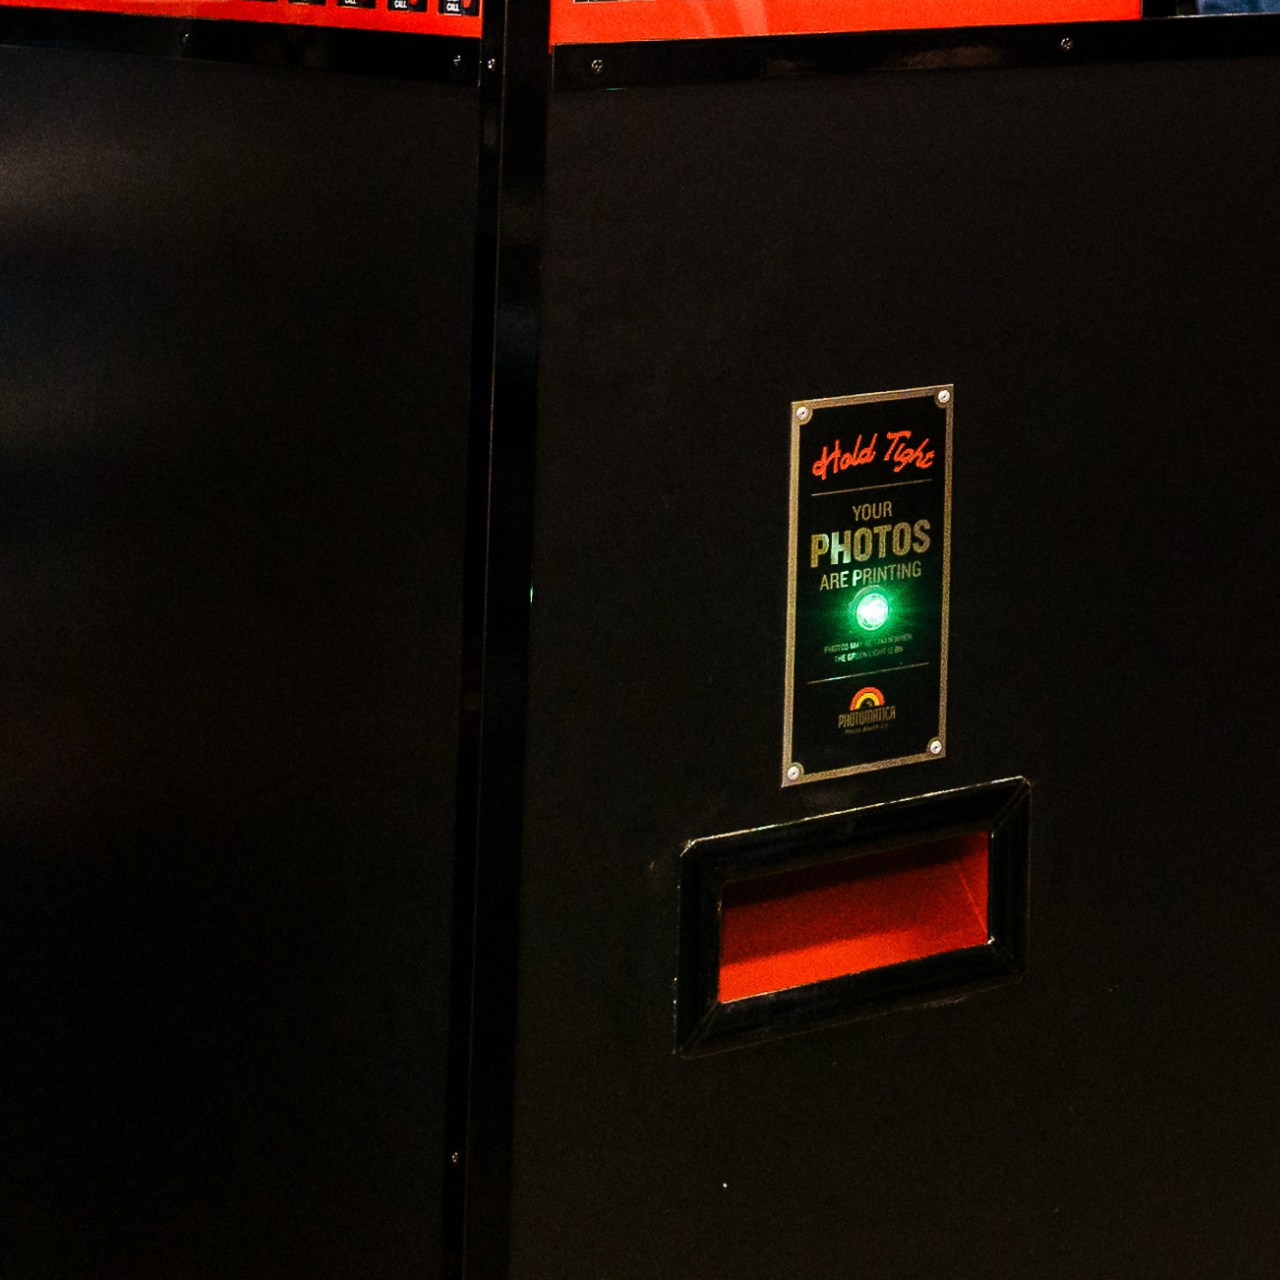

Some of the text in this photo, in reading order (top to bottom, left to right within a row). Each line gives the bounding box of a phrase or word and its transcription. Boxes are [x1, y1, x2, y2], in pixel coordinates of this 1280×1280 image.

[394, 0, 407, 9] CALL
[812, 430, 935, 480] Hold Tight
[852, 501, 893, 522] YOUR
[810, 519, 931, 568] PHOTOS
[820, 560, 922, 591] ARE PRINTING
[838, 703, 896, 730] PHOTOMATICA
